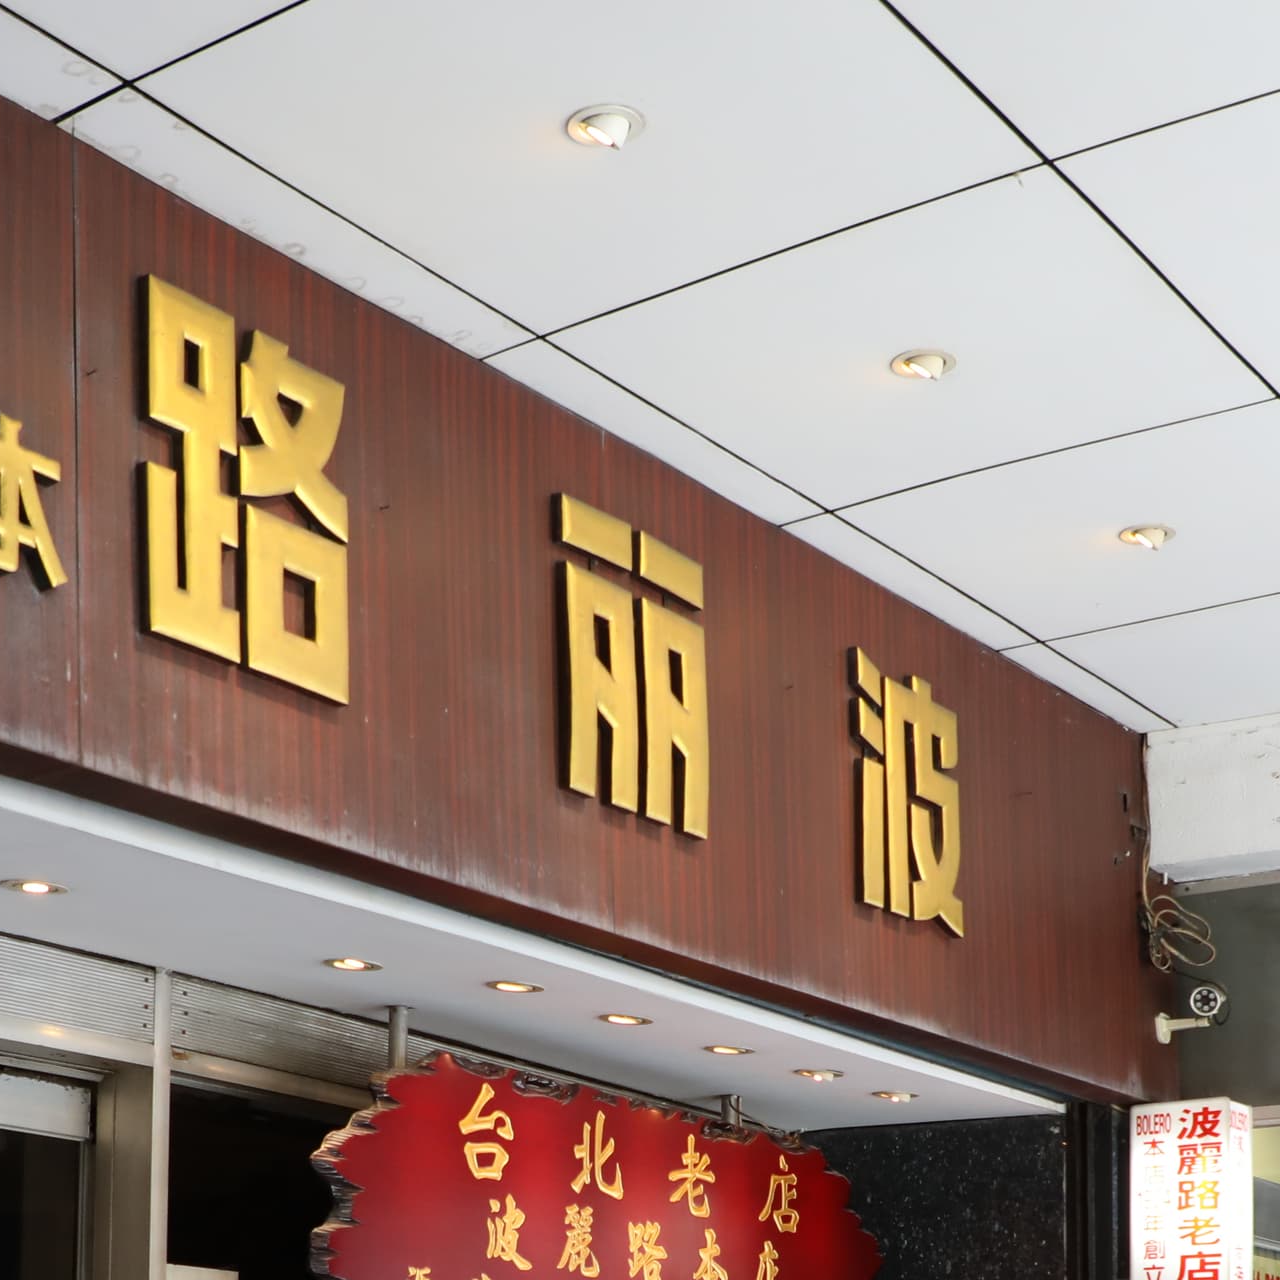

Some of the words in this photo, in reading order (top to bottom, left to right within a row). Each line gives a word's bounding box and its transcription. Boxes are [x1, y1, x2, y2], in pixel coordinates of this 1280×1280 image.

[458, 1082, 799, 1234] 台北老店
[1136, 1112, 1172, 1136] BOLERO
